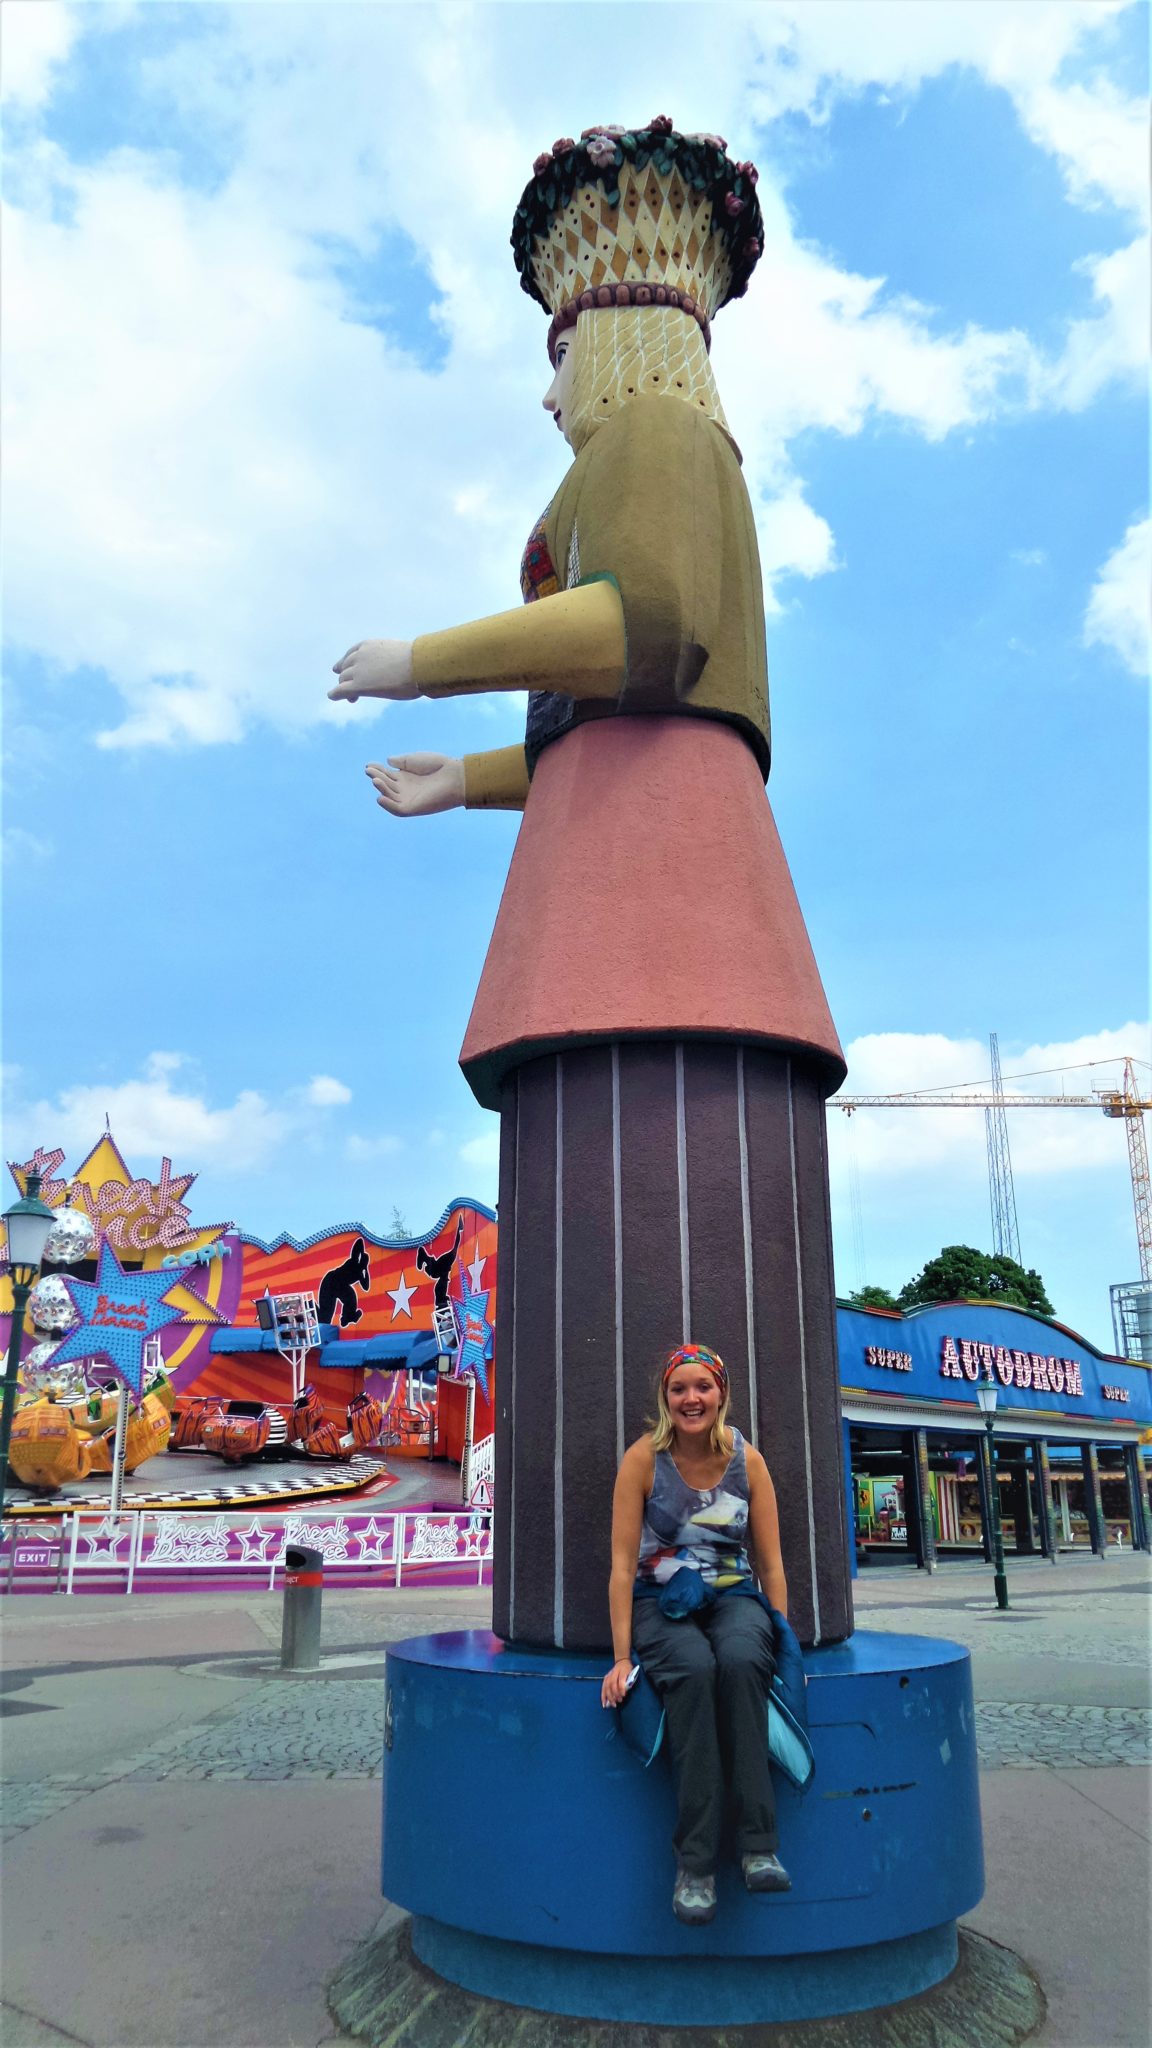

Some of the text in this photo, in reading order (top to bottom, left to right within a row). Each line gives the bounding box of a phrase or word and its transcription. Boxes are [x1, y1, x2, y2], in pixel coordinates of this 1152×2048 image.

[94, 1295, 149, 1318] Break
[90, 1315, 148, 1331] Dance
[865, 1346, 913, 1372] SUPER
[941, 1335, 1084, 1396] AUTODROM
[156, 1516, 230, 1546] Break
[283, 1517, 349, 1544] Break
[414, 1517, 458, 1542] Break
[18, 1553, 46, 1563] EXIT
[146, 1538, 229, 1562] Dance
[409, 1538, 458, 1557] Dance
